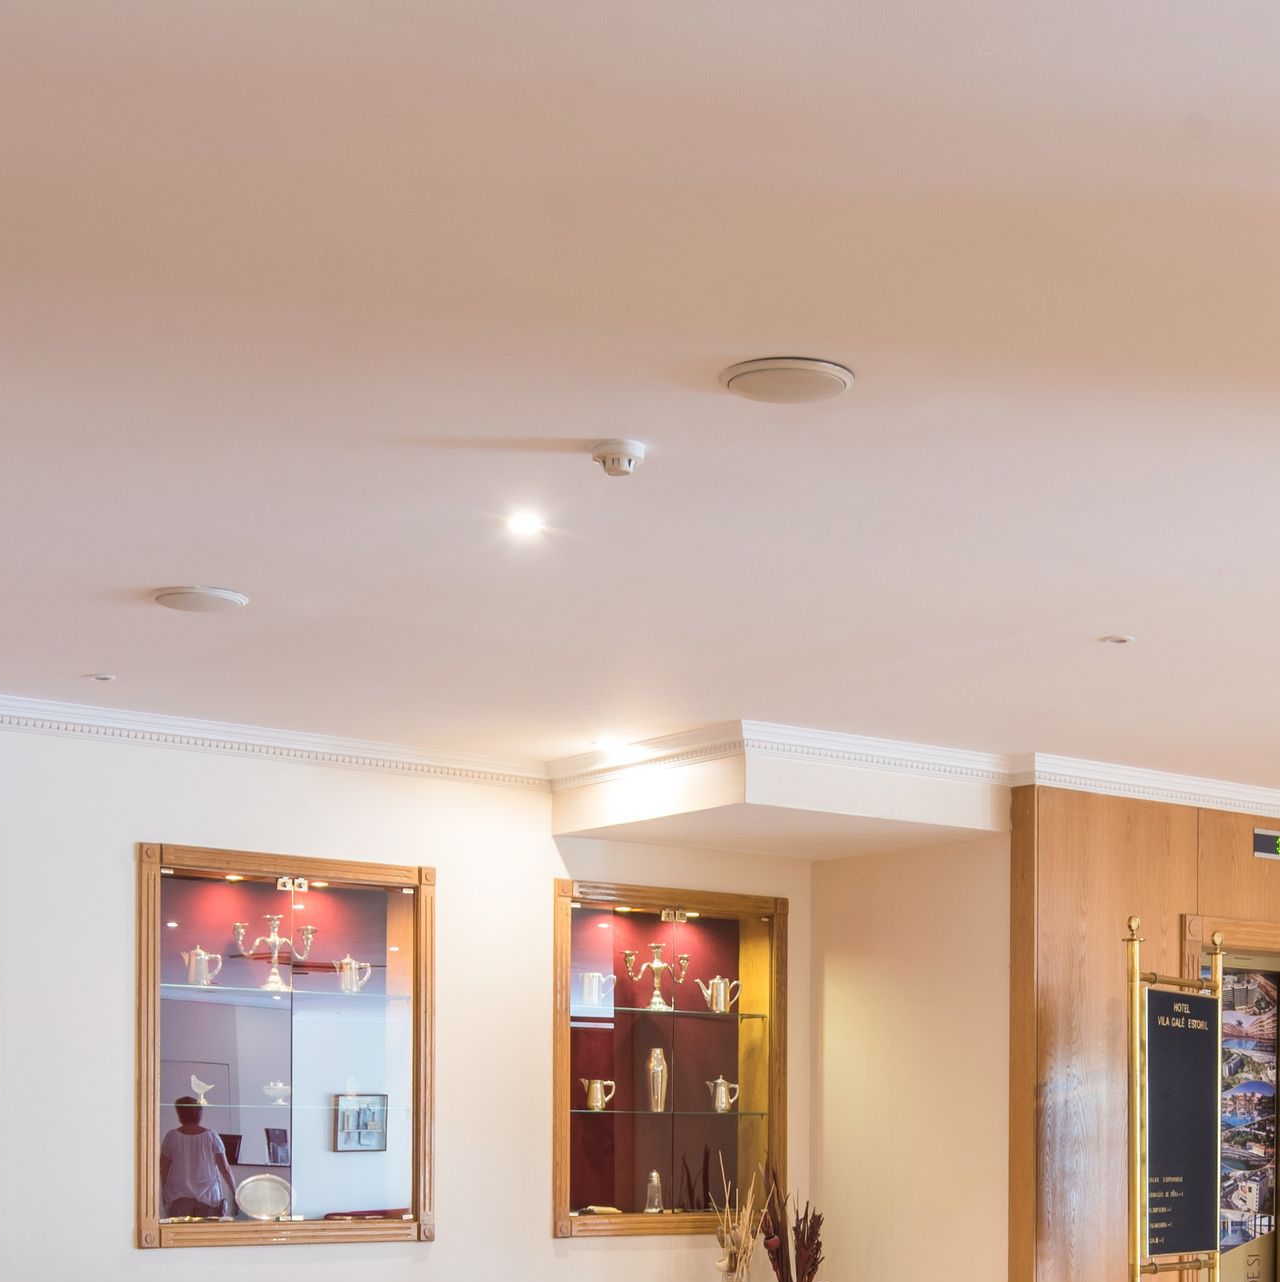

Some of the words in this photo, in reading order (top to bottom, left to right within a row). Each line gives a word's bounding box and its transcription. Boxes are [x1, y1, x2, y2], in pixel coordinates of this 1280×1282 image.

[1173, 1002, 1190, 1014] HOTEL
[1157, 1015, 1170, 1026] VILA
[1171, 1016, 1185, 1028] GALÉ
[1187, 1018, 1209, 1031] ESTORIL
[1247, 1254, 1260, 1267] SI
